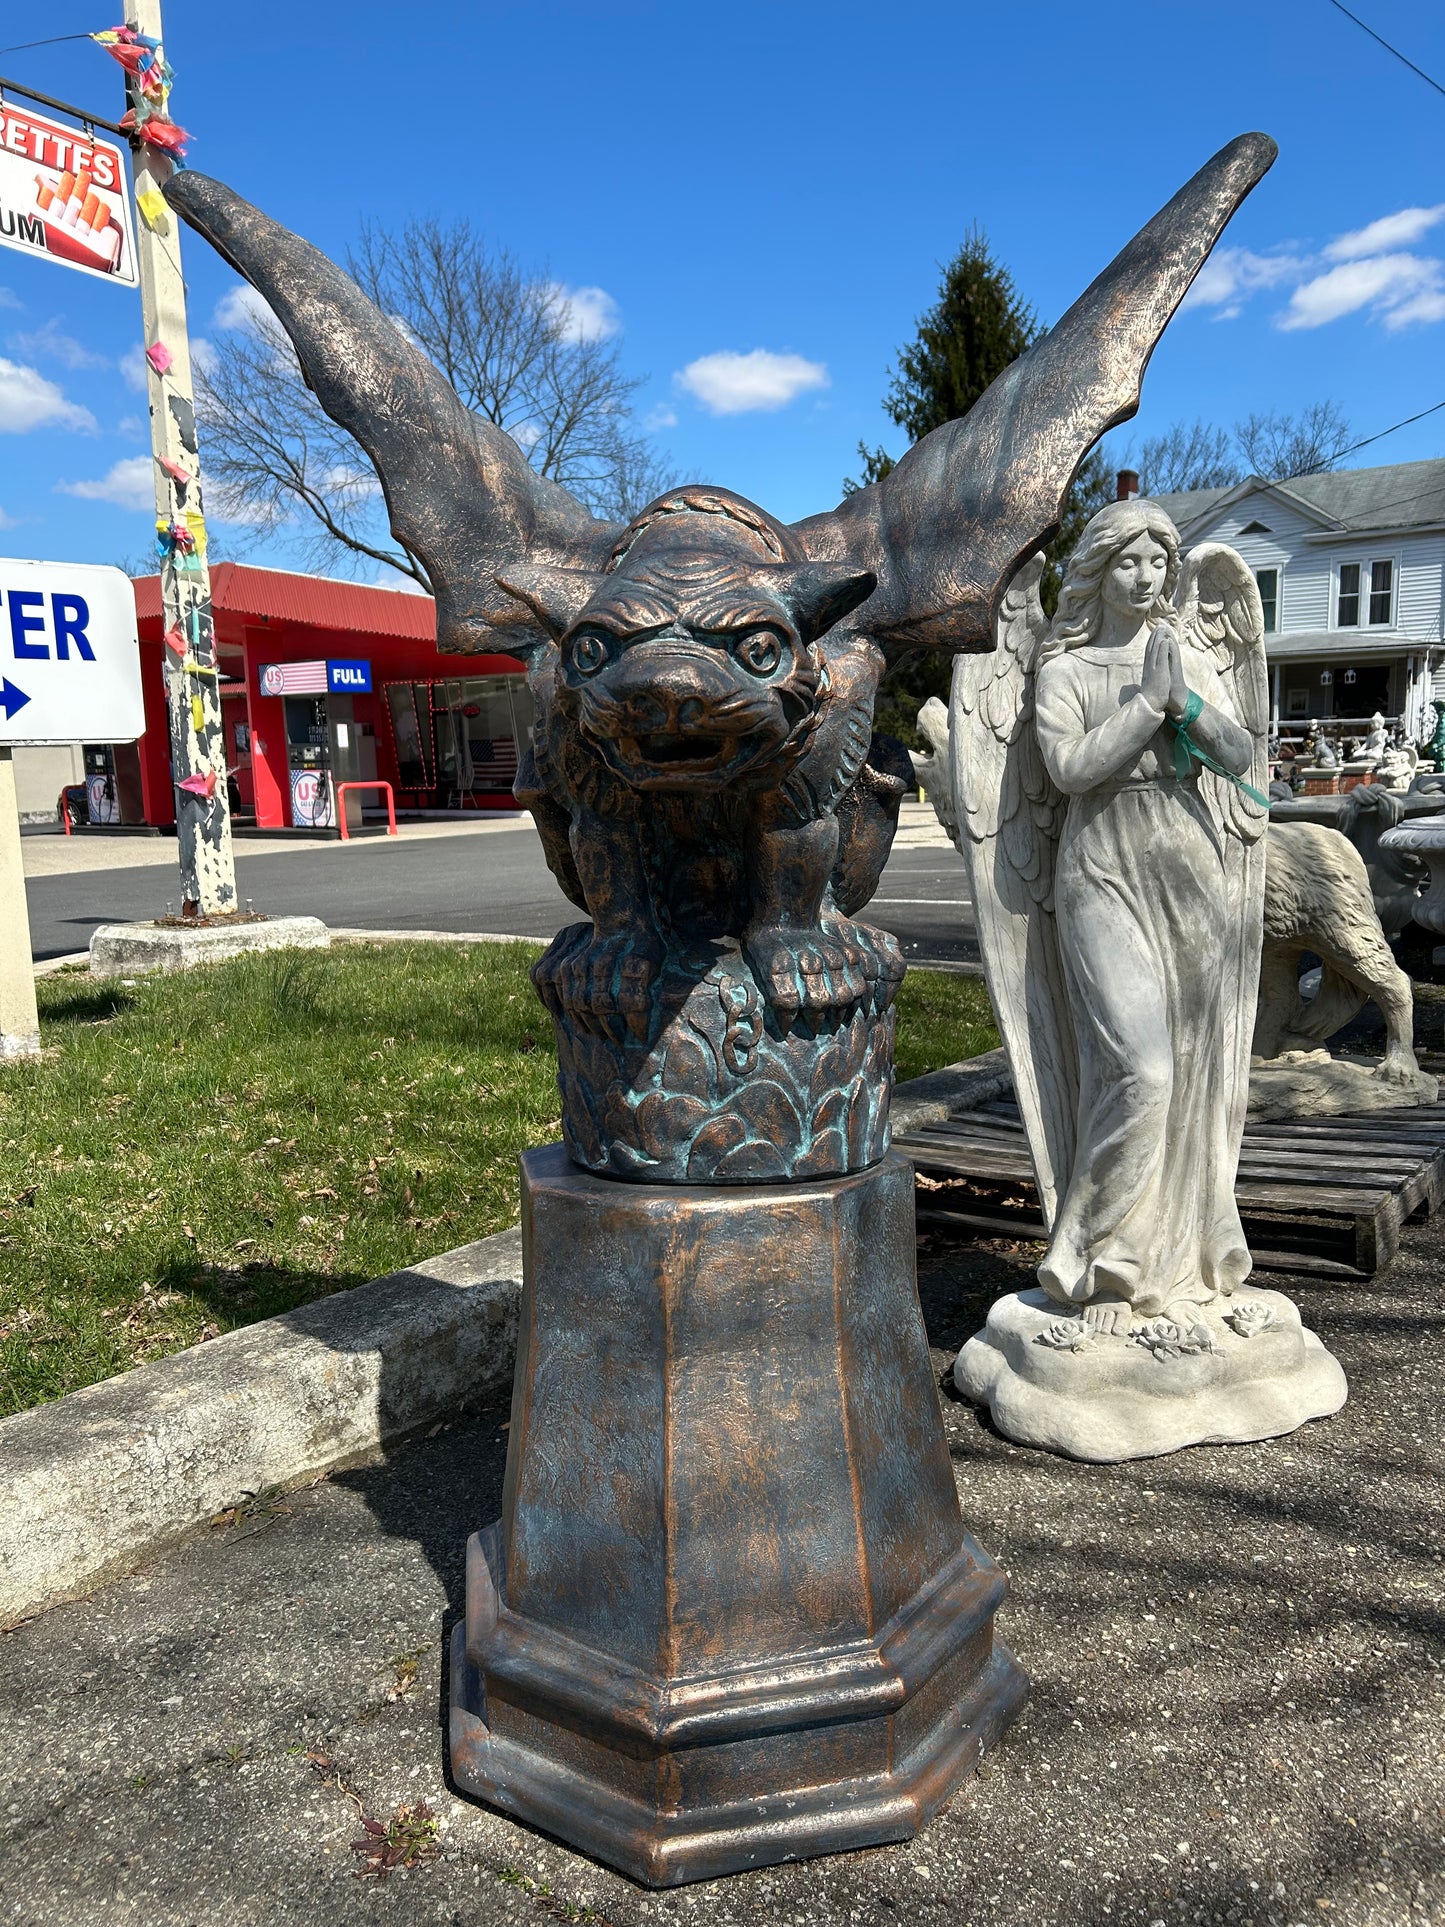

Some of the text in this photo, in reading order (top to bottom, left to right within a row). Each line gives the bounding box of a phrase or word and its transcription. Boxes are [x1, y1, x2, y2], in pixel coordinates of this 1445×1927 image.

[0, 113, 115, 186] ETTES
[0, 589, 97, 661] ER
[266, 670, 282, 683] US
[333, 669, 365, 684] FULL
